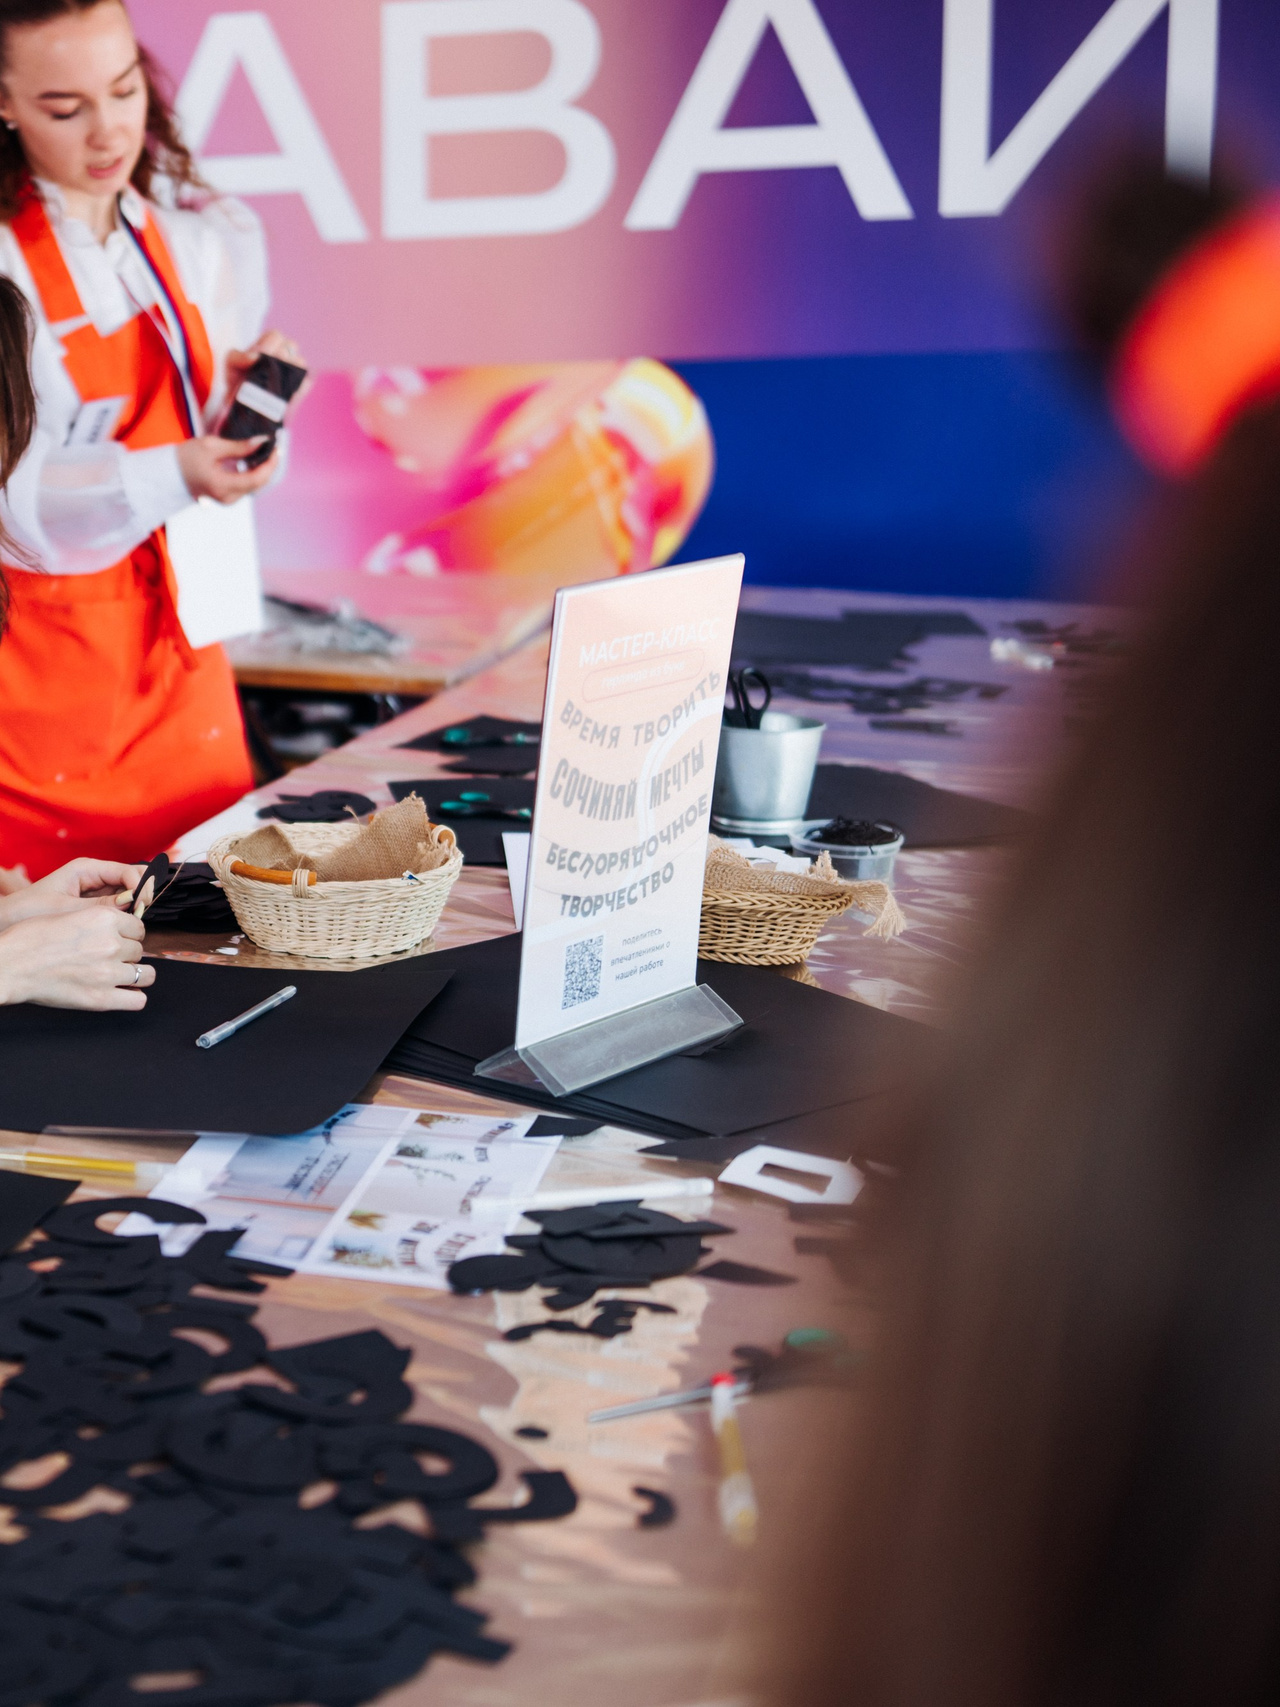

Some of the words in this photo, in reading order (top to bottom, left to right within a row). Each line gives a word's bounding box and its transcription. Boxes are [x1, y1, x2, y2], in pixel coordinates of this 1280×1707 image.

[578, 617, 721, 668] МАСТЕР-КЛАСС
[560, 699, 621, 749] ВРЕМЯ
[633, 670, 720, 747] ТВОРИТЬ
[550, 758, 637, 821] СОЧИНЯЙ
[649, 739, 704, 809] МЕЧТЫ
[546, 793, 708, 879] БЕСПОРЯДОЧНОЕ
[560, 862, 674, 917] ТВОРЧЕСТВО
[639, 960, 664, 975] работе
